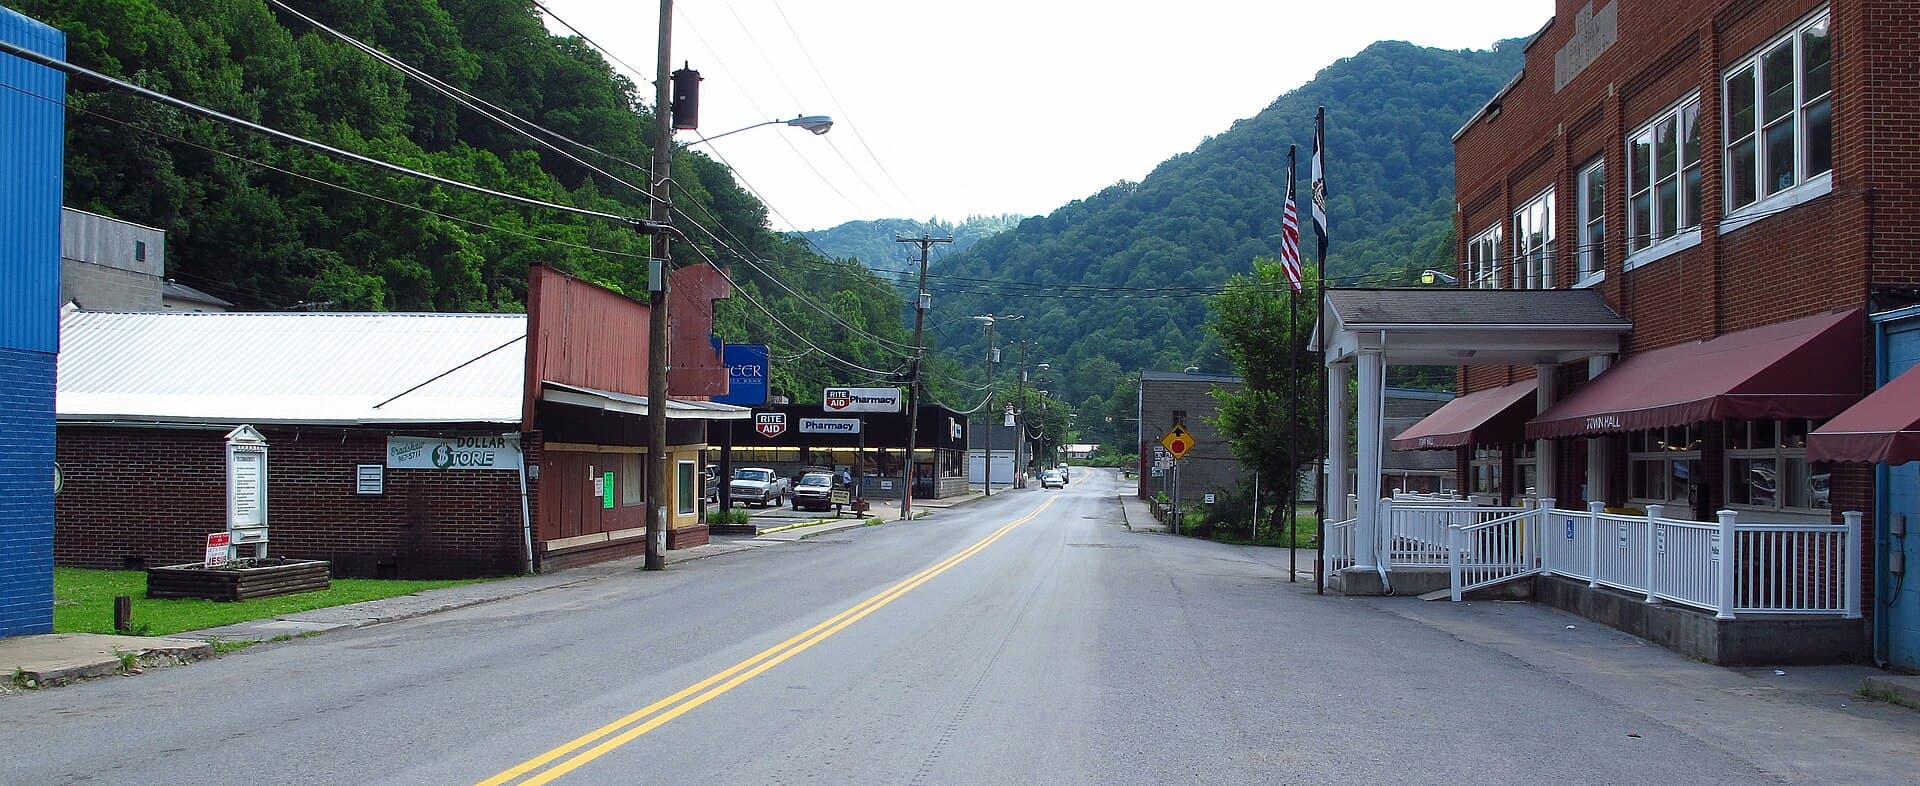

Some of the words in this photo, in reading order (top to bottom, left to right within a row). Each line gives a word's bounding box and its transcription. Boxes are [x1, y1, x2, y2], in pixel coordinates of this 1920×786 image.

[830, 399, 846, 407] AID
[850, 395, 896, 405] Pharmacy
[760, 415, 782, 423] RITE
[1586, 416, 1604, 430] TOWN
[1604, 415, 1621, 428] HALL
[762, 425, 780, 433] AID
[805, 421, 854, 431] Pharmacy
[457, 436, 506, 449] DOLLAR
